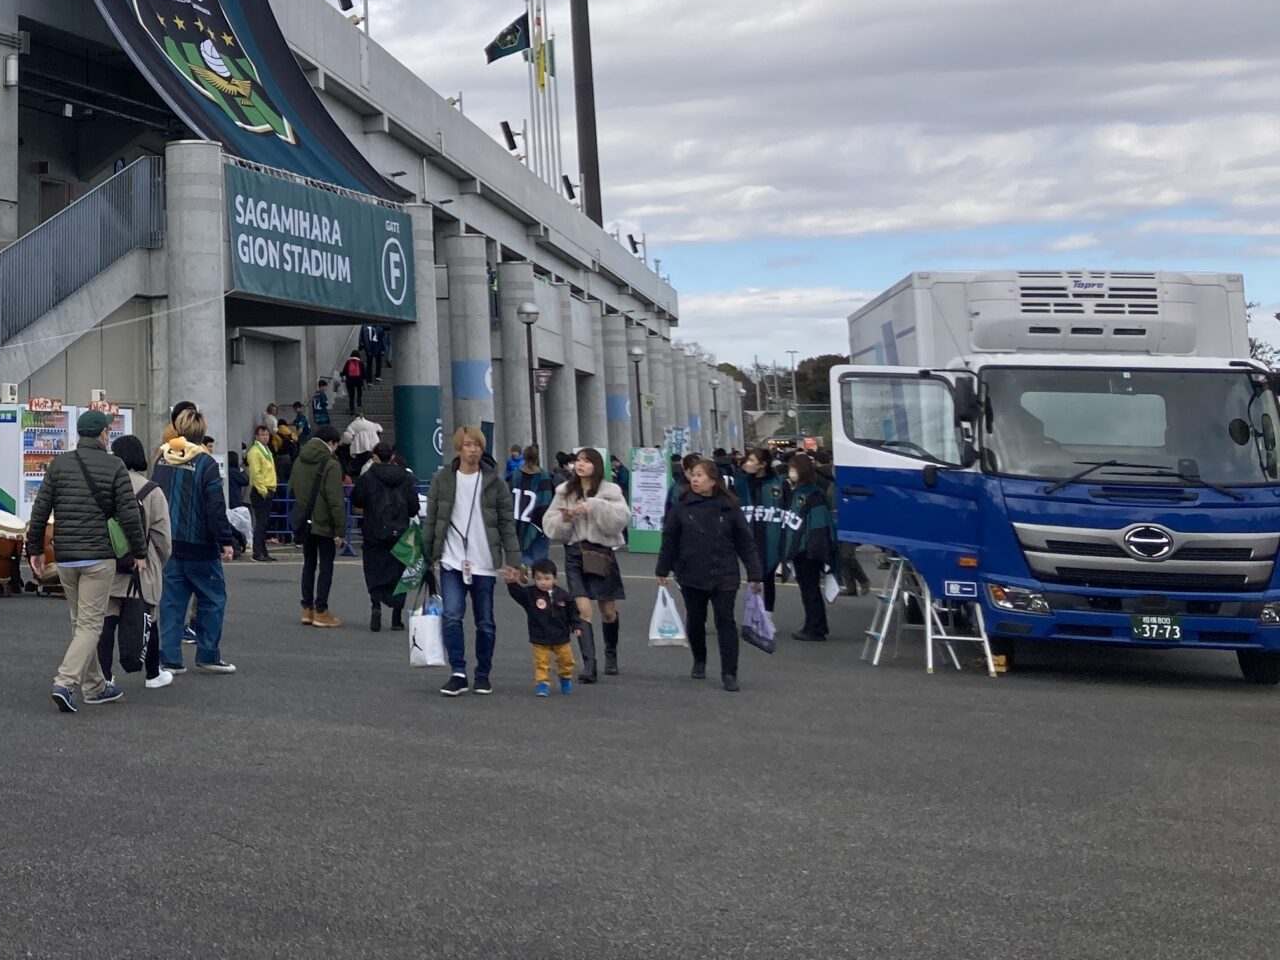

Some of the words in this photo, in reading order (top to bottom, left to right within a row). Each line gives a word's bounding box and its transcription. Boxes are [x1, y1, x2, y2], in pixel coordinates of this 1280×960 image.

[235, 194, 343, 247] SAGAMIHARA
[385, 220, 400, 234] GATE
[237, 233, 280, 270] GION
[282, 242, 352, 284] STADIUM
[389, 252, 401, 290] F
[1073, 280, 1104, 289] Topre
[512, 487, 537, 522] 12
[1142, 625, 1181, 638] 37-73
